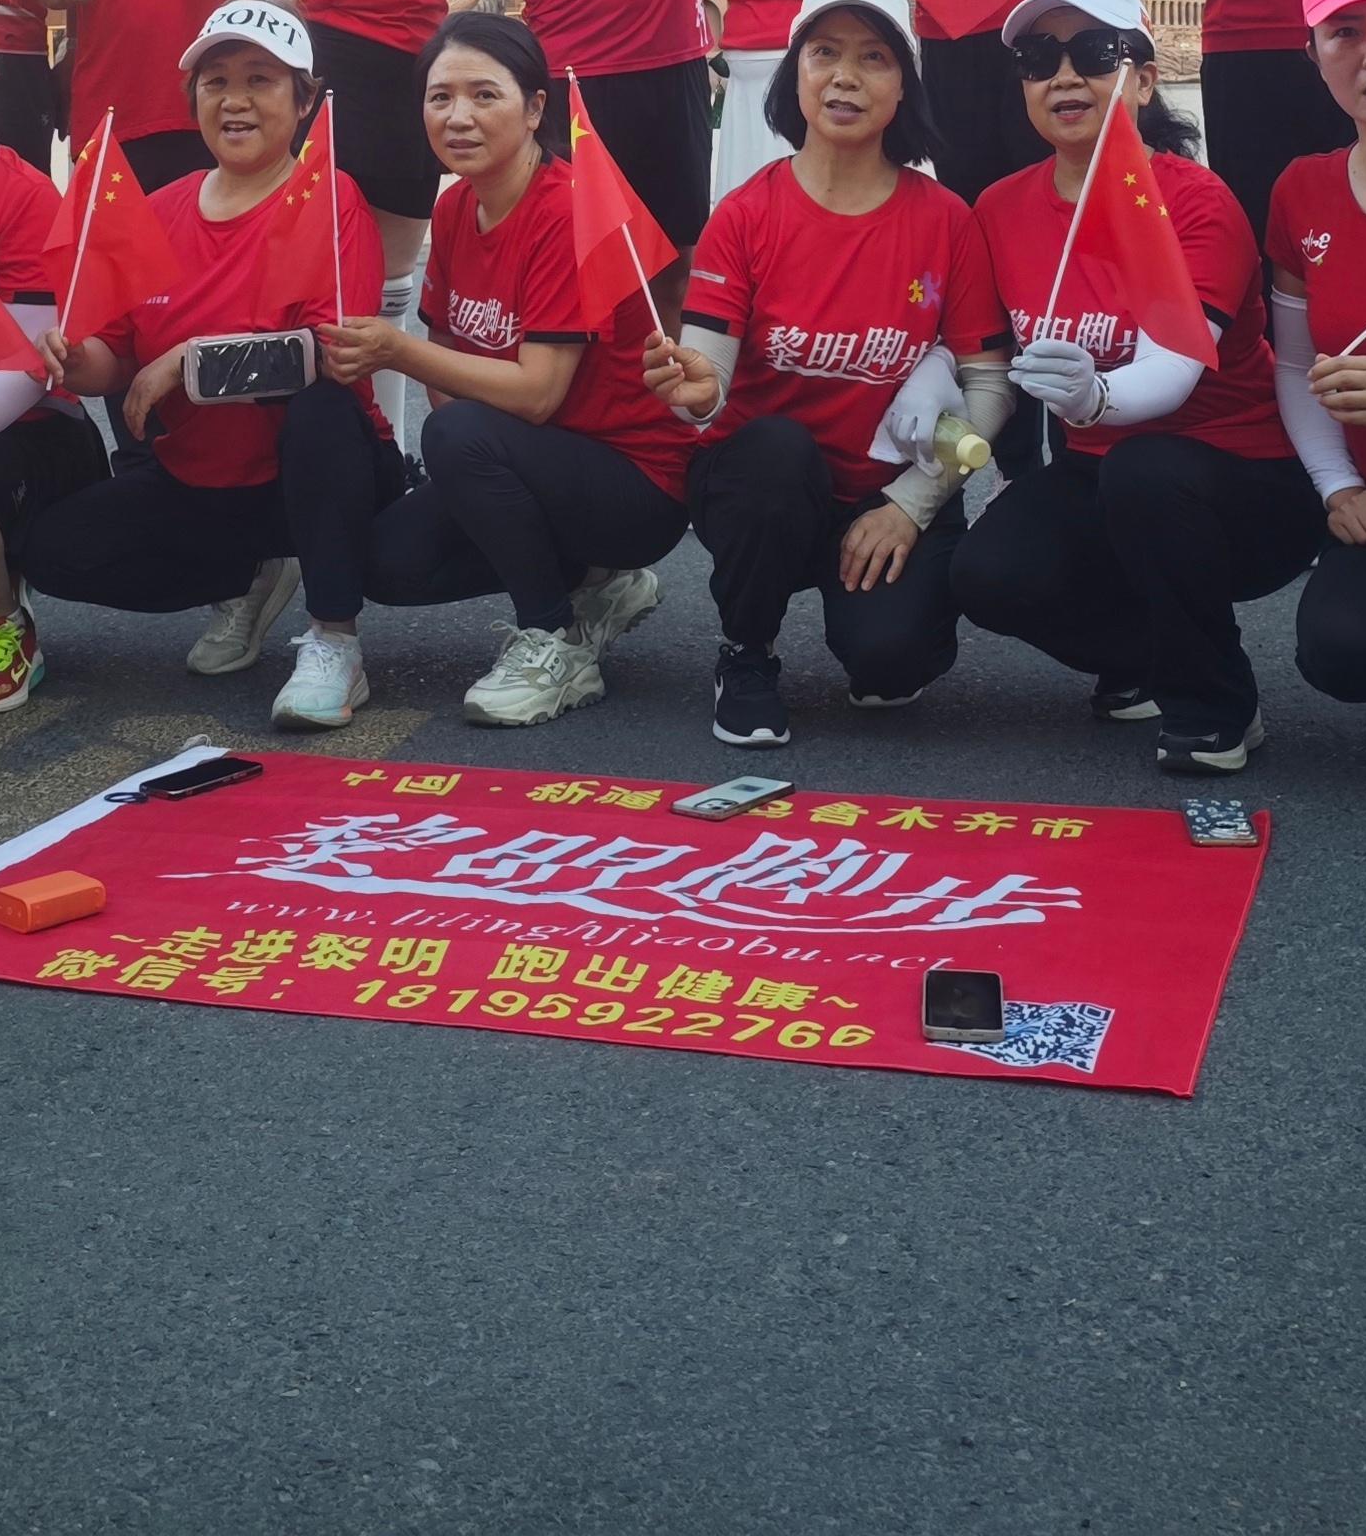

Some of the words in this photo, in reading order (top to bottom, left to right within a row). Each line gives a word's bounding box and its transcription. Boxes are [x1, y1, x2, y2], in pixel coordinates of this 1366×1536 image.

[235, 813, 1082, 926] 黎明脚步
[352, 976, 877, 1050] 18195922766
